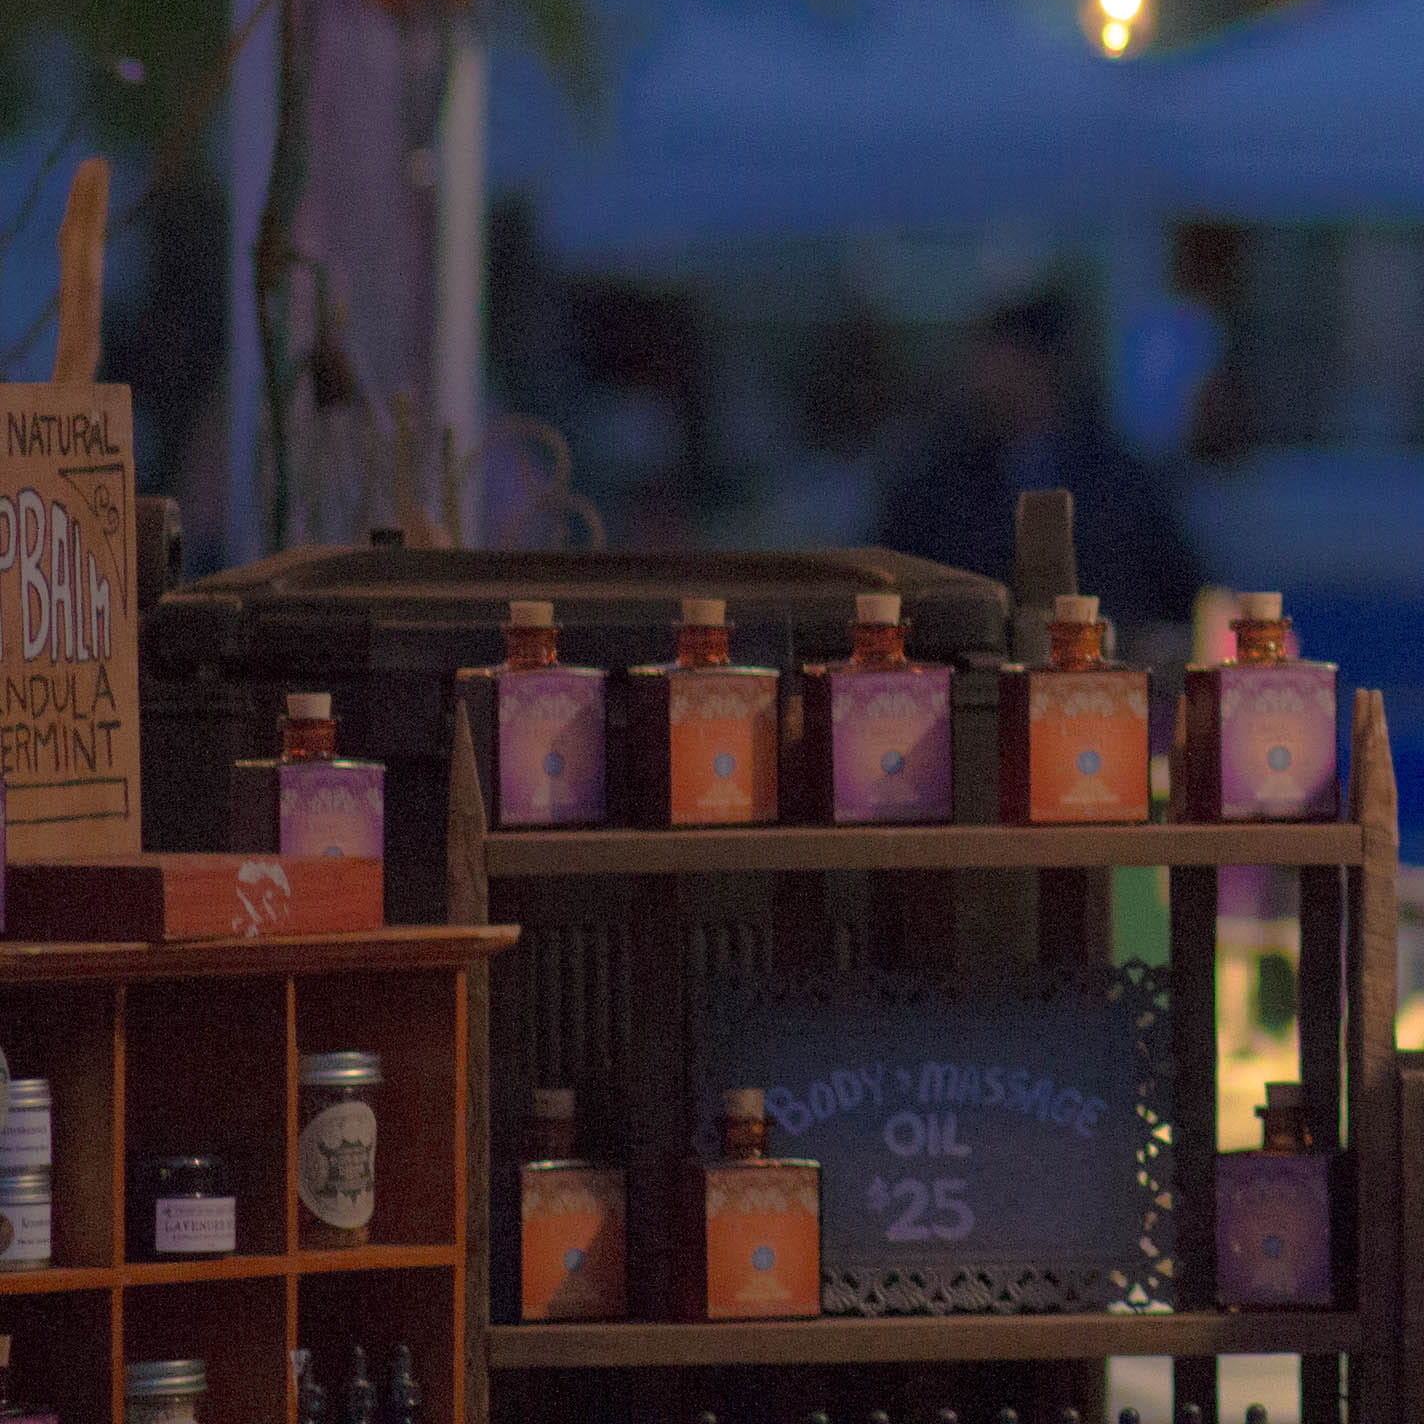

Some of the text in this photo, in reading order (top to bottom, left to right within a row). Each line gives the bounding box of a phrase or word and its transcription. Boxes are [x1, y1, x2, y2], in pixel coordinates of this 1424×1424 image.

[7, 411, 119, 457] NATURAL
[0, 664, 116, 719] NDULA
[763, 1062, 886, 1136] BODY
[917, 1061, 1108, 1138] MASSAGE
[883, 1110, 973, 1158] OIL
[866, 1175, 977, 1242] $25
